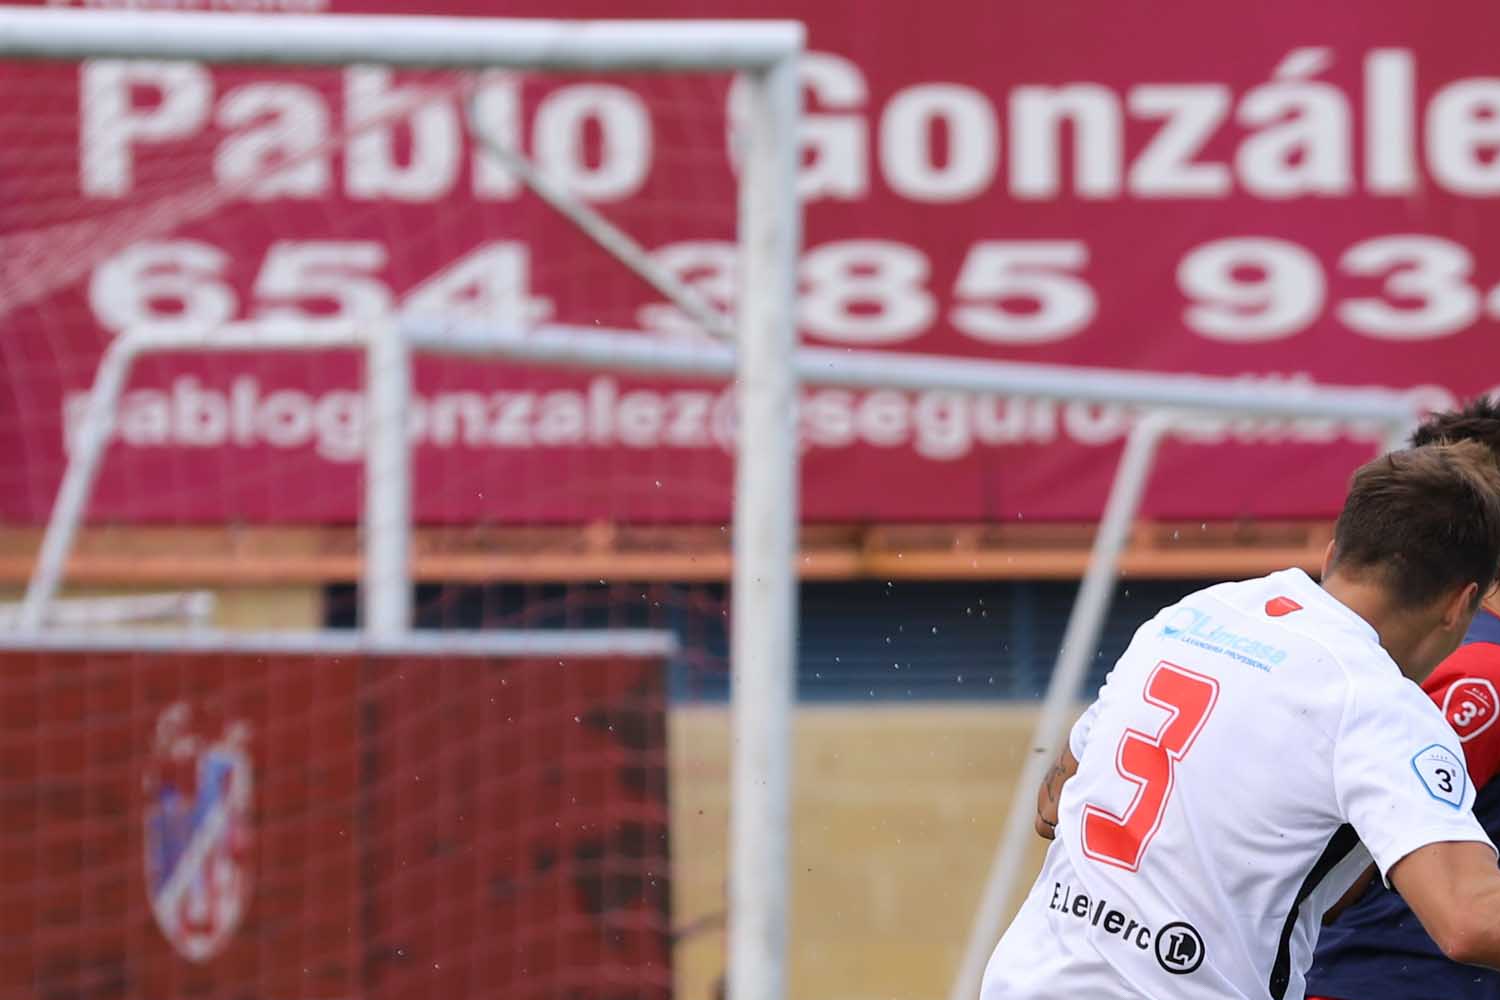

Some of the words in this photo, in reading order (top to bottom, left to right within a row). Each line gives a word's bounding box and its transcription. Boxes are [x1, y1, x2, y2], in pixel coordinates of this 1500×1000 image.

[79, 58, 652, 199] Pablo
[88, 237, 554, 333] 654
[636, 238, 1098, 346] 385
[1081, 660, 1220, 872] 3
[1049, 882, 1151, 950] E.Lelerc
